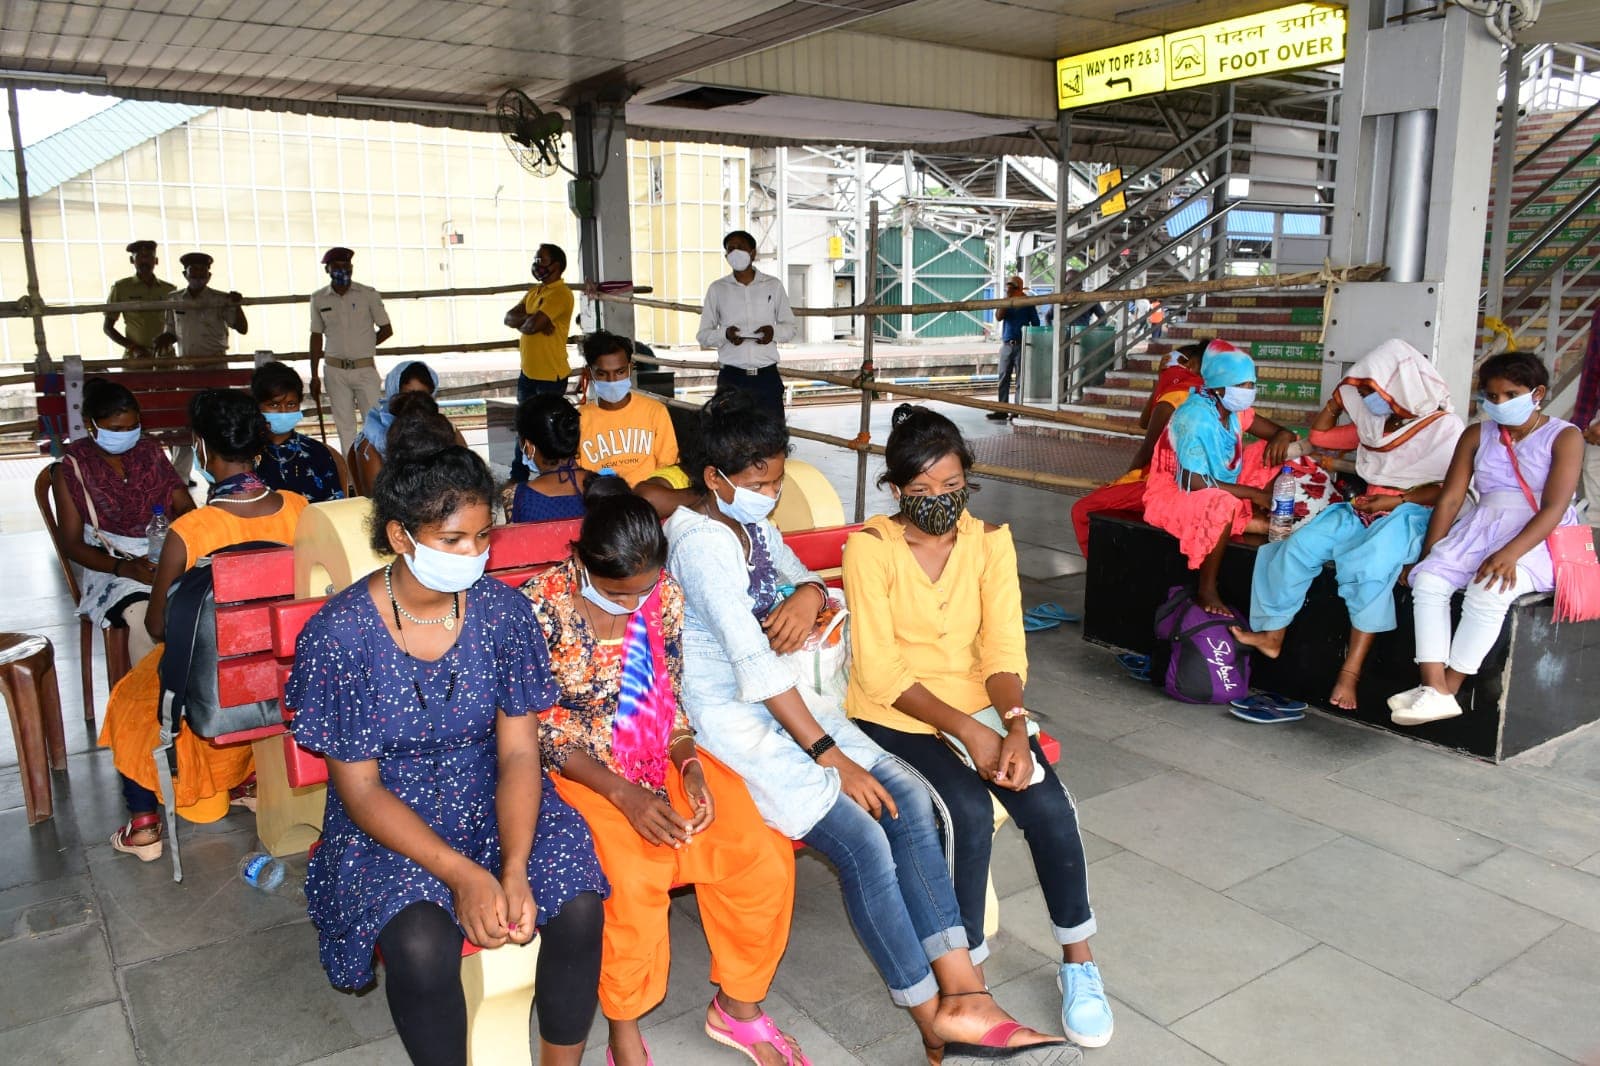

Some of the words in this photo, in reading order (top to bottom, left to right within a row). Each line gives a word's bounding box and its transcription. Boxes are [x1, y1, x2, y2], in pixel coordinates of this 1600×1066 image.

[1086, 60, 1106, 77] WAY
[1109, 57, 1120, 72] TO
[1124, 53, 1135, 69] PF
[1138, 51, 1144, 66] 2
[1154, 48, 1160, 63] 3
[1219, 49, 1269, 72] FOOT
[1278, 37, 1333, 60] OVER
[582, 428, 653, 464] CALVIN
